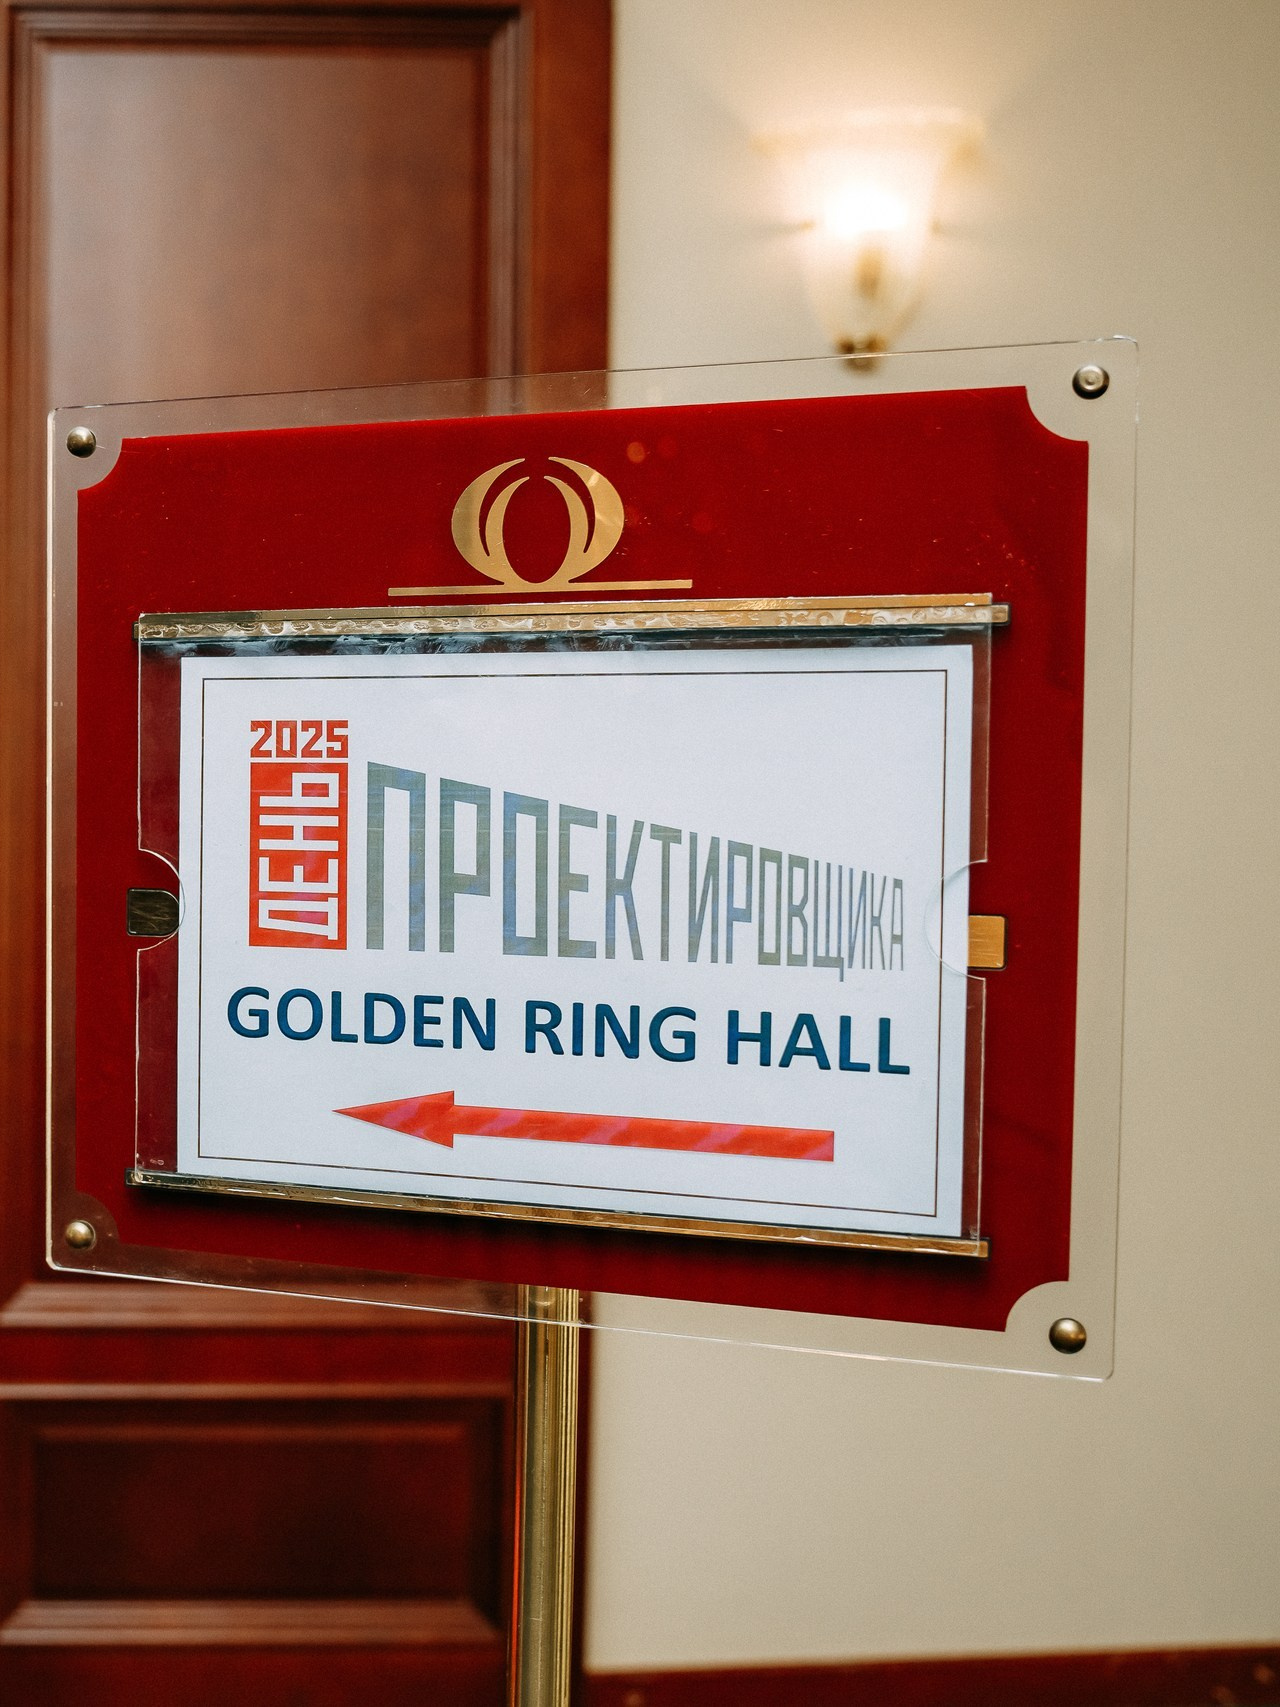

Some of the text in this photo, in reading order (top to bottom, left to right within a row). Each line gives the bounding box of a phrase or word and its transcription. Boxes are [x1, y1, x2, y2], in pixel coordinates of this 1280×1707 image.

[250, 720, 349, 758] 2025
[258, 772, 340, 941] ДЕНЬ
[366, 761, 904, 982] ПРОЕКТИРОВЩИКА
[227, 986, 911, 1075] GOLDEN RING HALL
